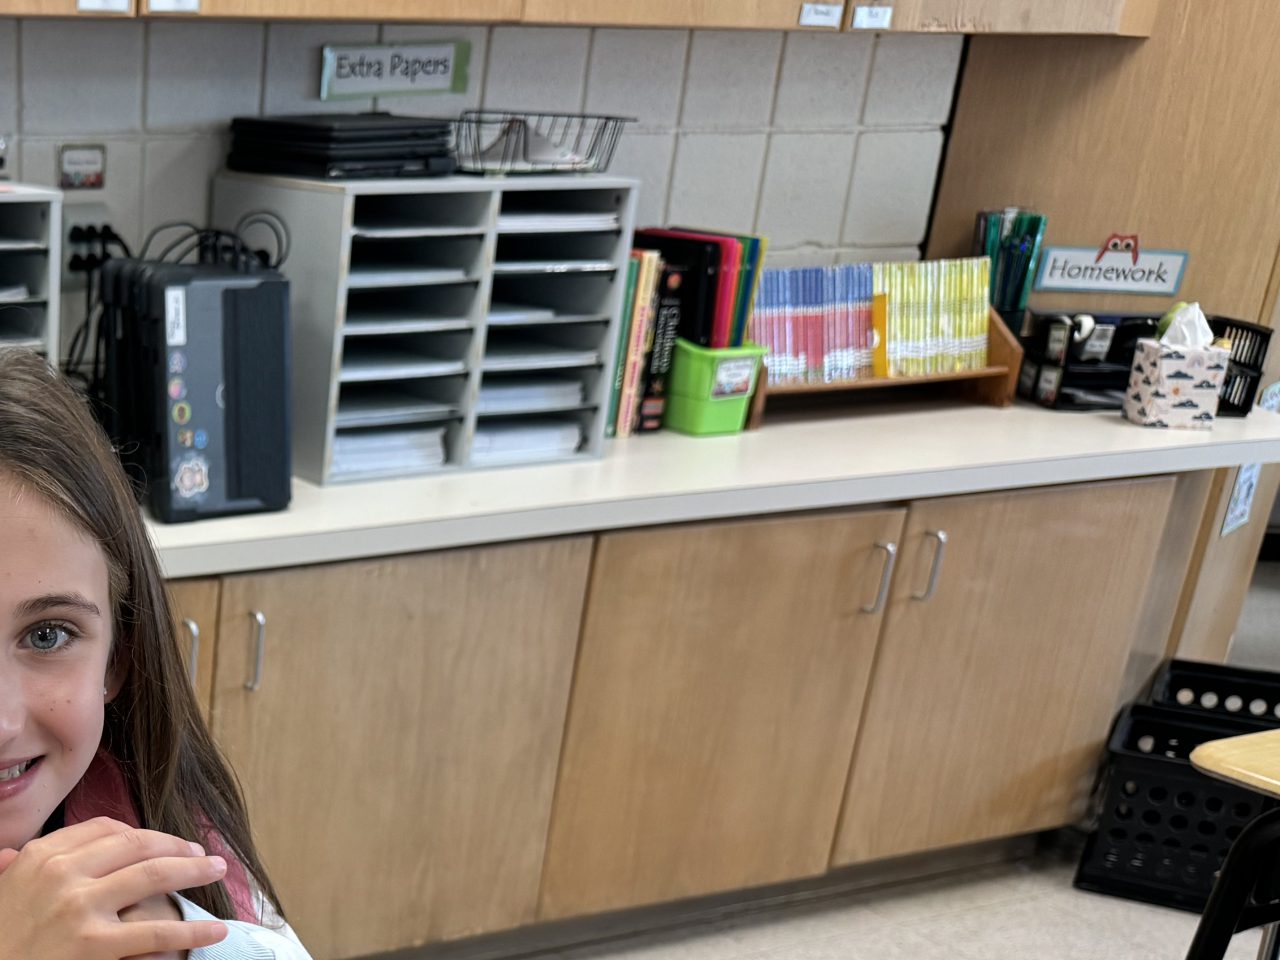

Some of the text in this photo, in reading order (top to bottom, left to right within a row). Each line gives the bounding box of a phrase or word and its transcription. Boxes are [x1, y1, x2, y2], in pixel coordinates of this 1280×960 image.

[335, 52, 450, 83] Extra Papers
[1048, 256, 1168, 284] Homework
